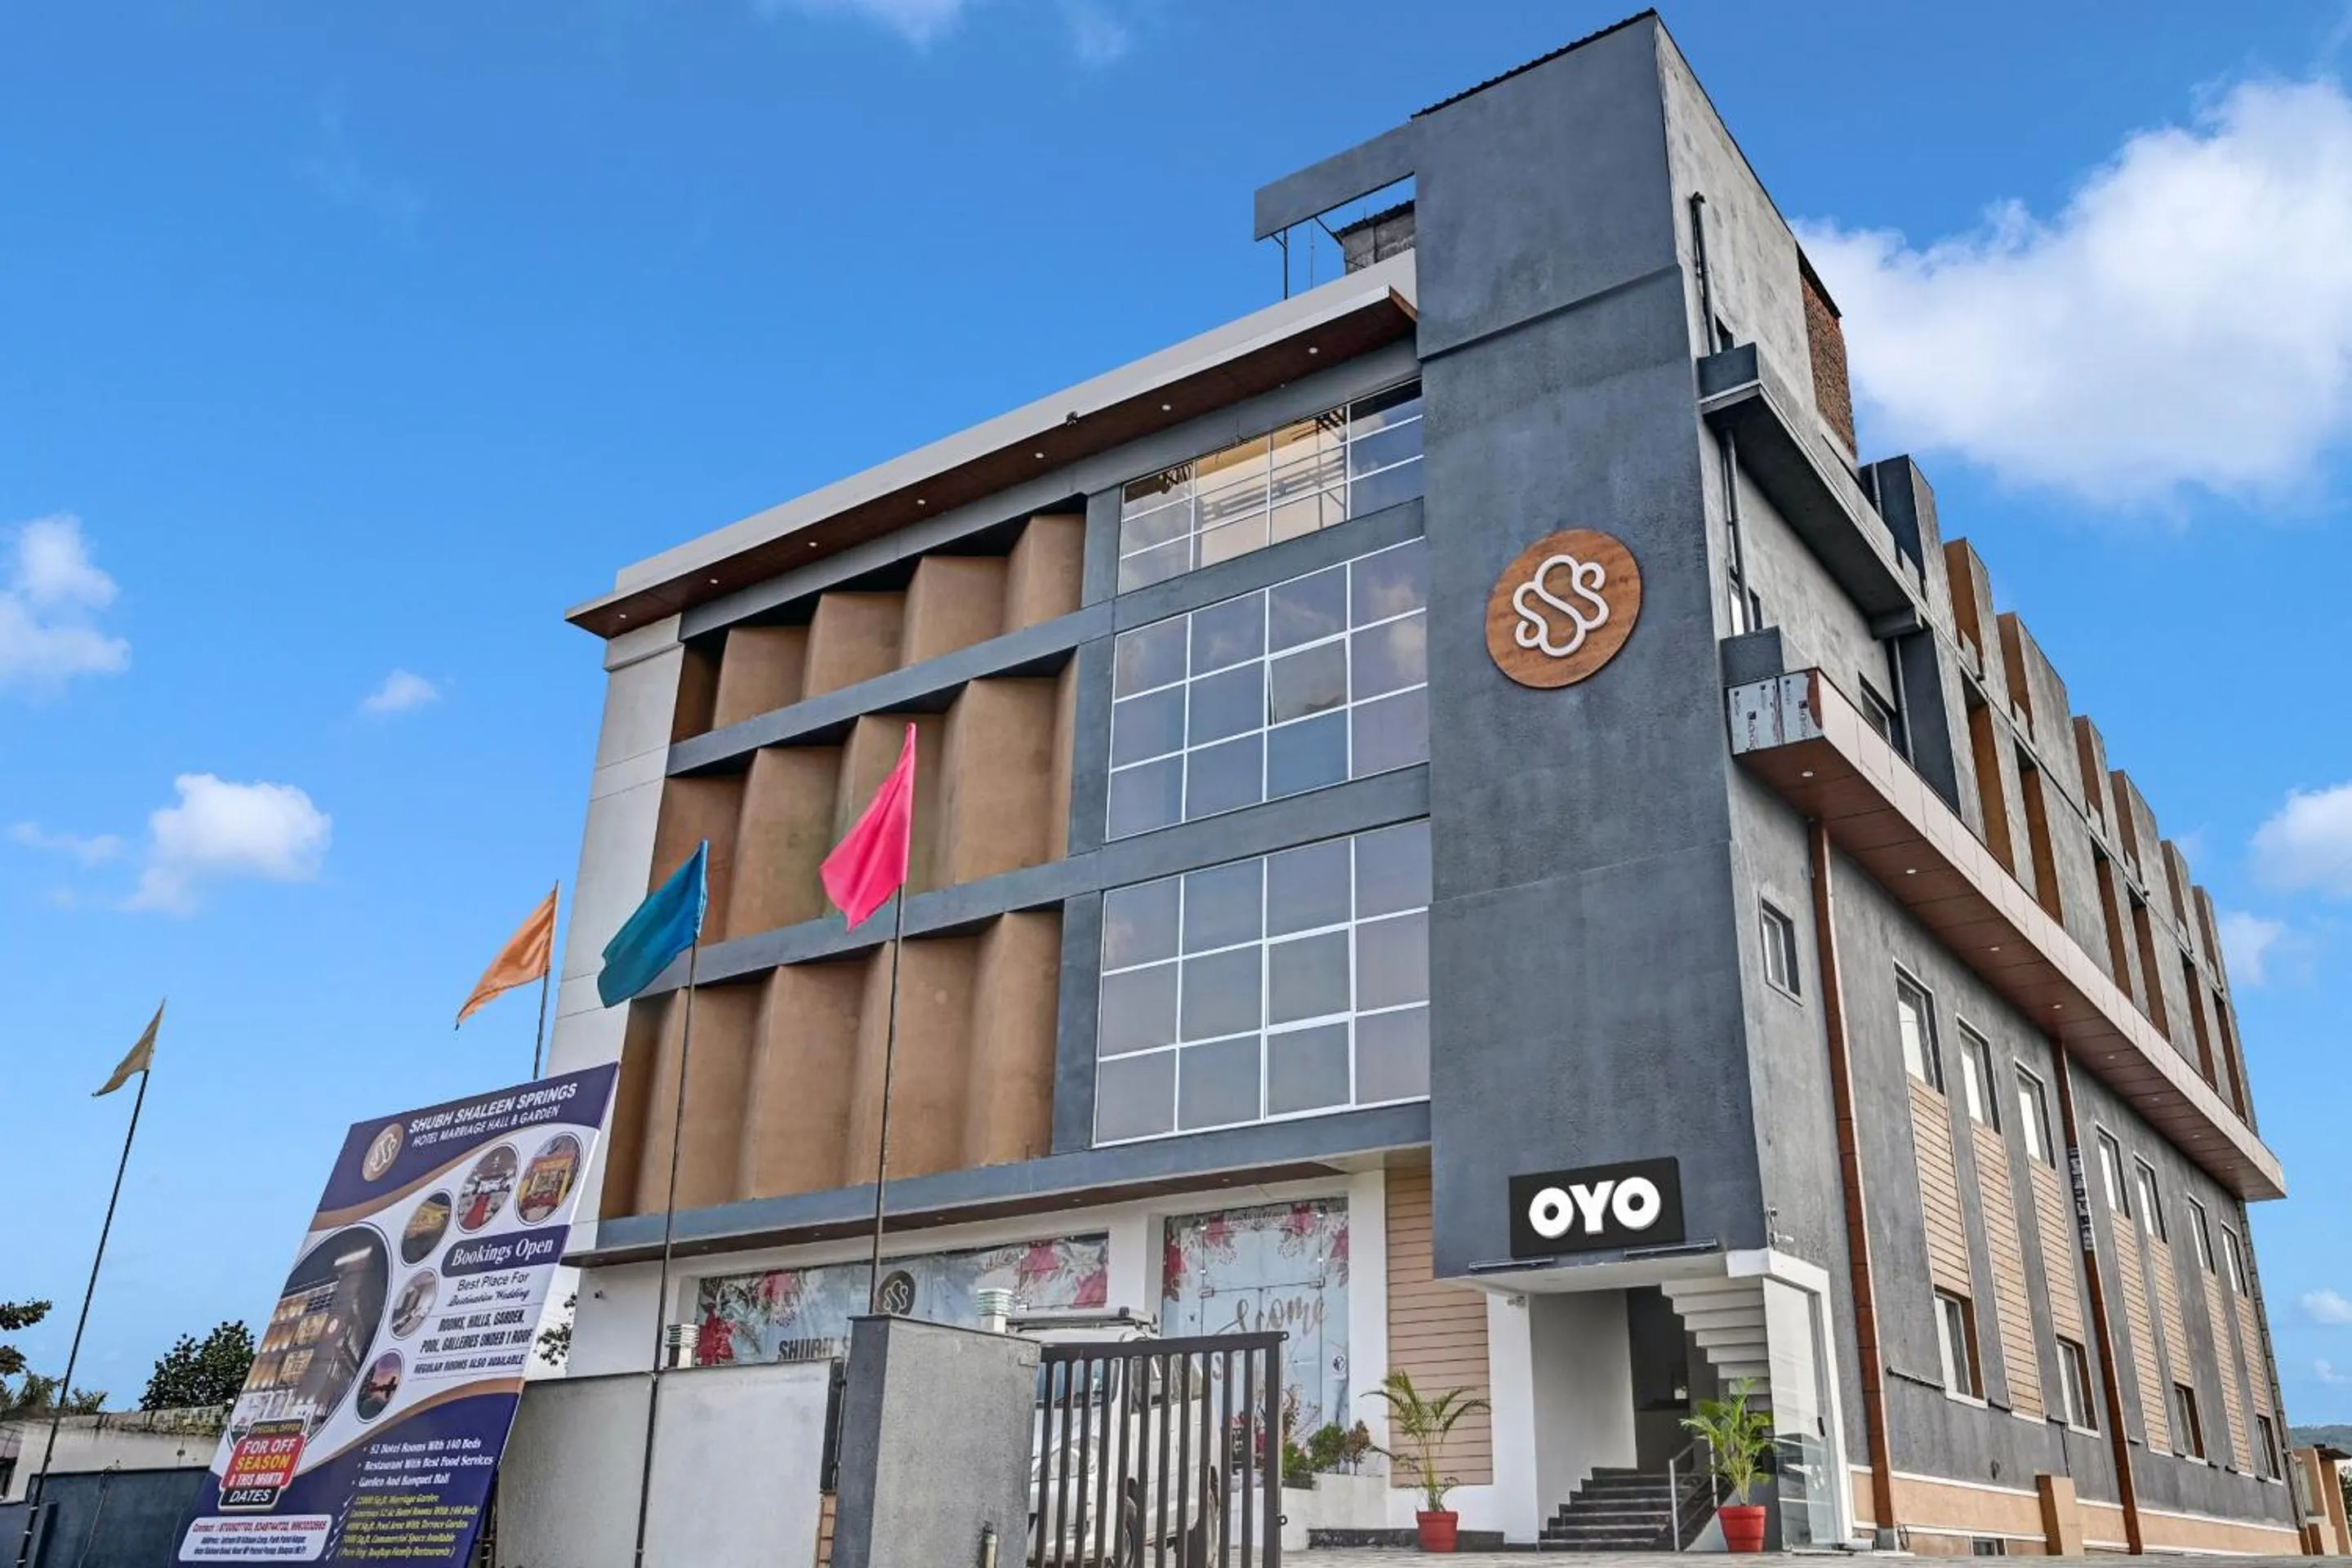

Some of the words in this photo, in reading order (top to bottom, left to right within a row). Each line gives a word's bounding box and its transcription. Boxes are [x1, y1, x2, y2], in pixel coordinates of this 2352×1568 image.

[409, 1111, 452, 1134] SHUBH
[454, 1098, 515, 1124] SHALEEN
[516, 1083, 578, 1110] SPRINGS
[412, 1132, 439, 1147] HOTEL
[439, 1122, 486, 1143] MARRIAGE
[487, 1116, 509, 1131] HALL
[519, 1104, 561, 1125] GARDEN
[1529, 1177, 1661, 1239] OYO
[452, 1244, 511, 1266] Bookings
[515, 1238, 554, 1260] Open
[457, 1278, 479, 1291] Best
[481, 1276, 508, 1288] Place
[510, 1271, 530, 1283] For
[468, 1357, 487, 1368] ALSO
[486, 1354, 525, 1366] AVAILABLE
[243, 1440, 270, 1454] FOR
[271, 1438, 297, 1452] OFF
[234, 1454, 291, 1470] SEASON
[440, 1456, 460, 1468] Food
[461, 1454, 494, 1466] Services
[229, 1489, 272, 1503] DATES
